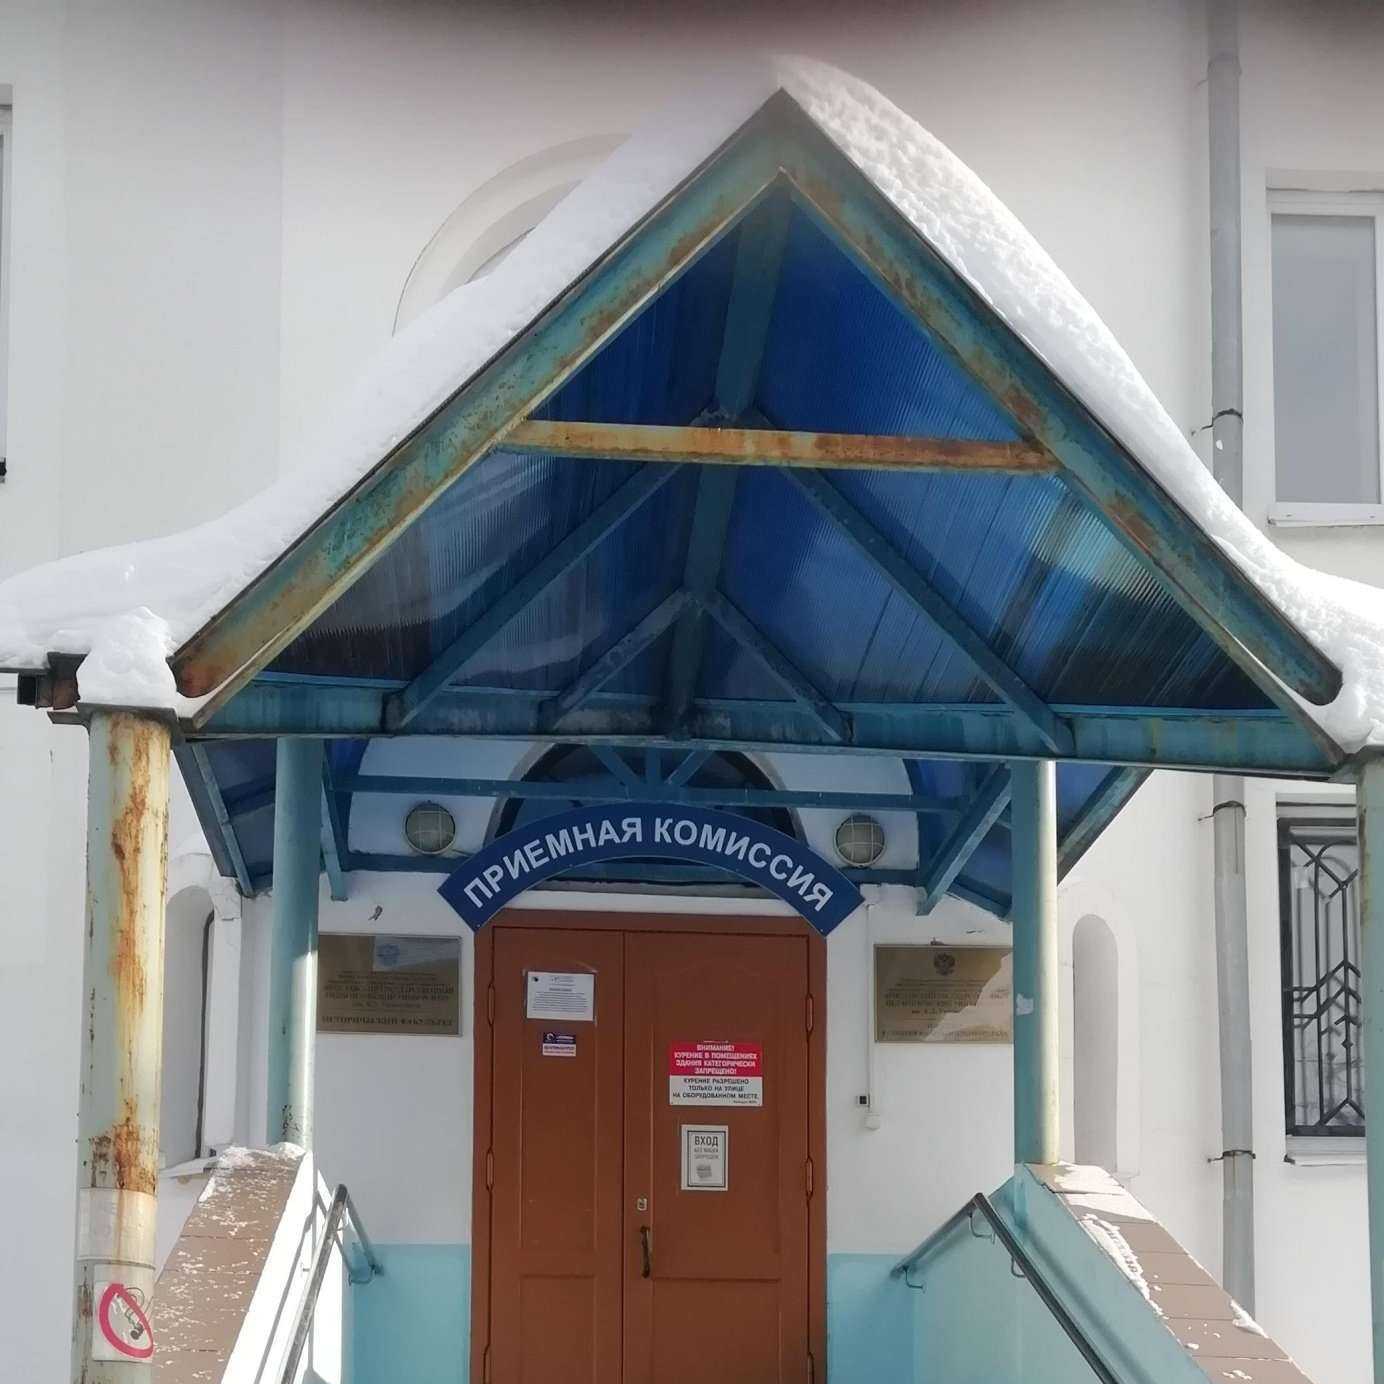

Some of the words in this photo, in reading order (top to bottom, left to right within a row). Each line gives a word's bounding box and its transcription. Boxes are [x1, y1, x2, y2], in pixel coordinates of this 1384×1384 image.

[463, 817, 643, 909] ПРИЕМНАЯ
[654, 817, 834, 912] КОМИССИЯ
[703, 1060, 756, 1068] КАТЕГОРИЧЕСКИ
[694, 1135, 719, 1147] ВХОД
